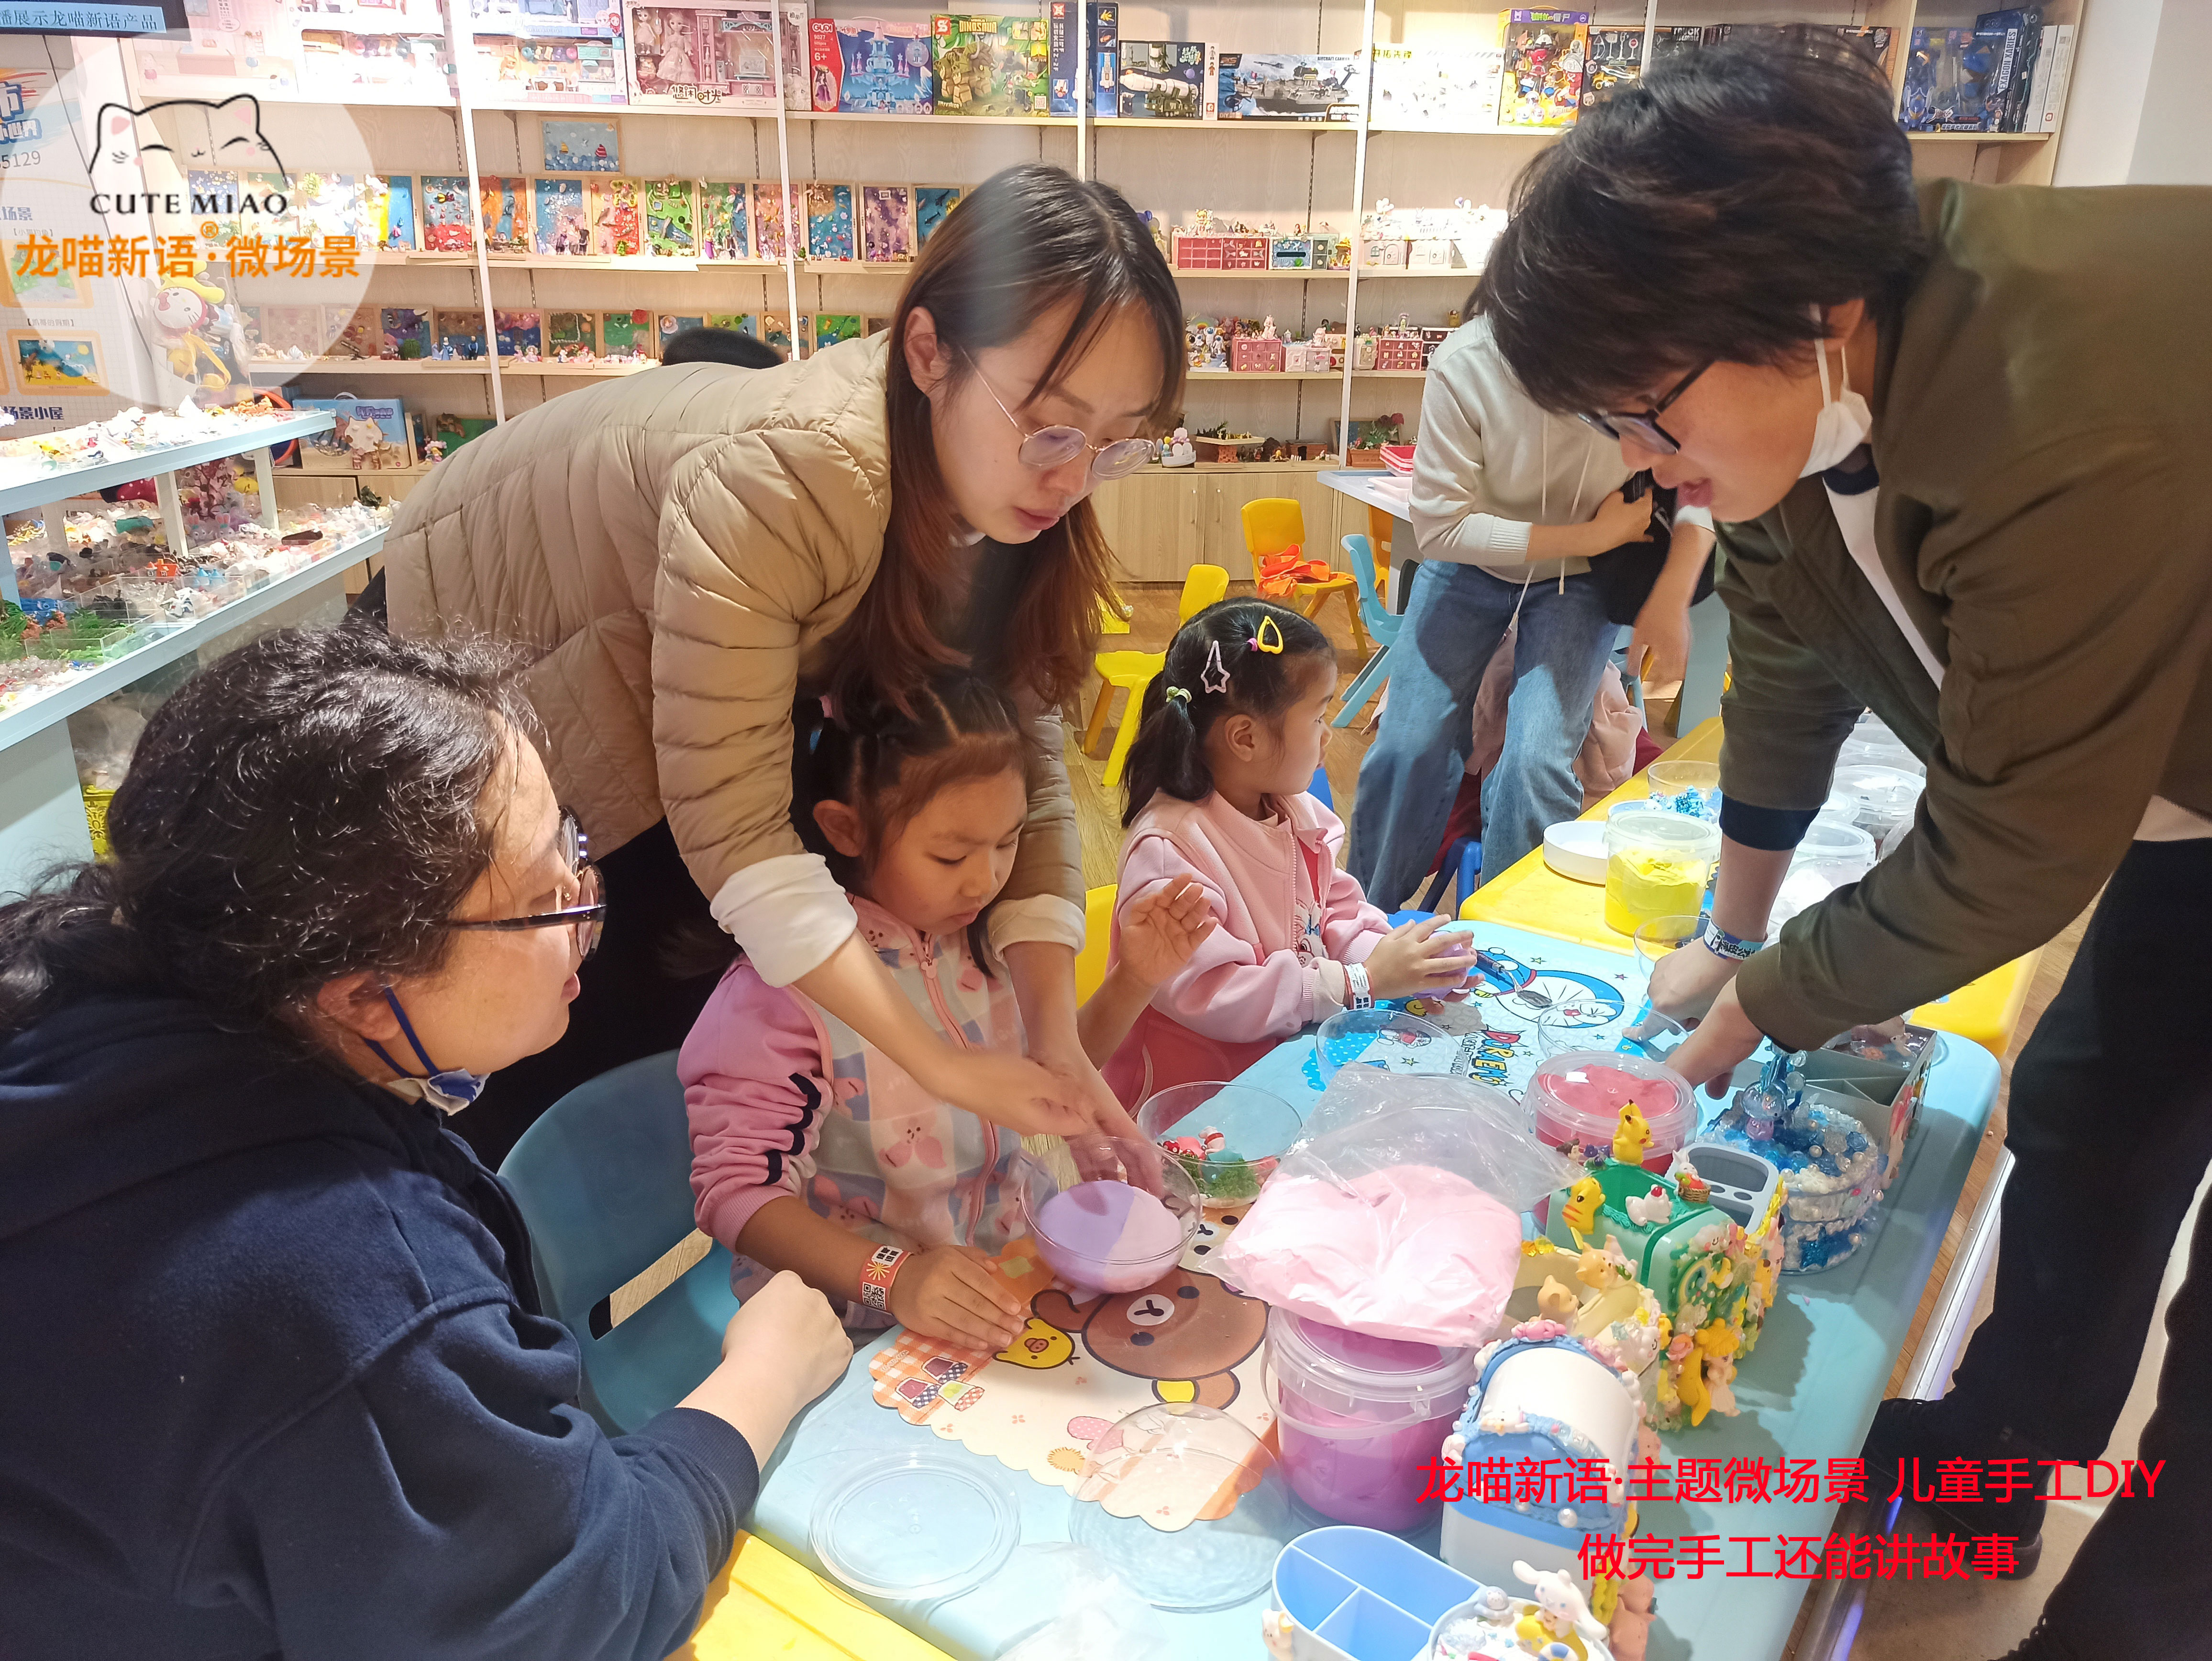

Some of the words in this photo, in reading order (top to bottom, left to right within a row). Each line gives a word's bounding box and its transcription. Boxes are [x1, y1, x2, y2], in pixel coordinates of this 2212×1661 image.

[815, 52, 827, 61] 6+
[0, 151, 41, 168] 5129
[0, 206, 33, 221] 场景
[1469, 1028, 1521, 1086] DORAEMO
